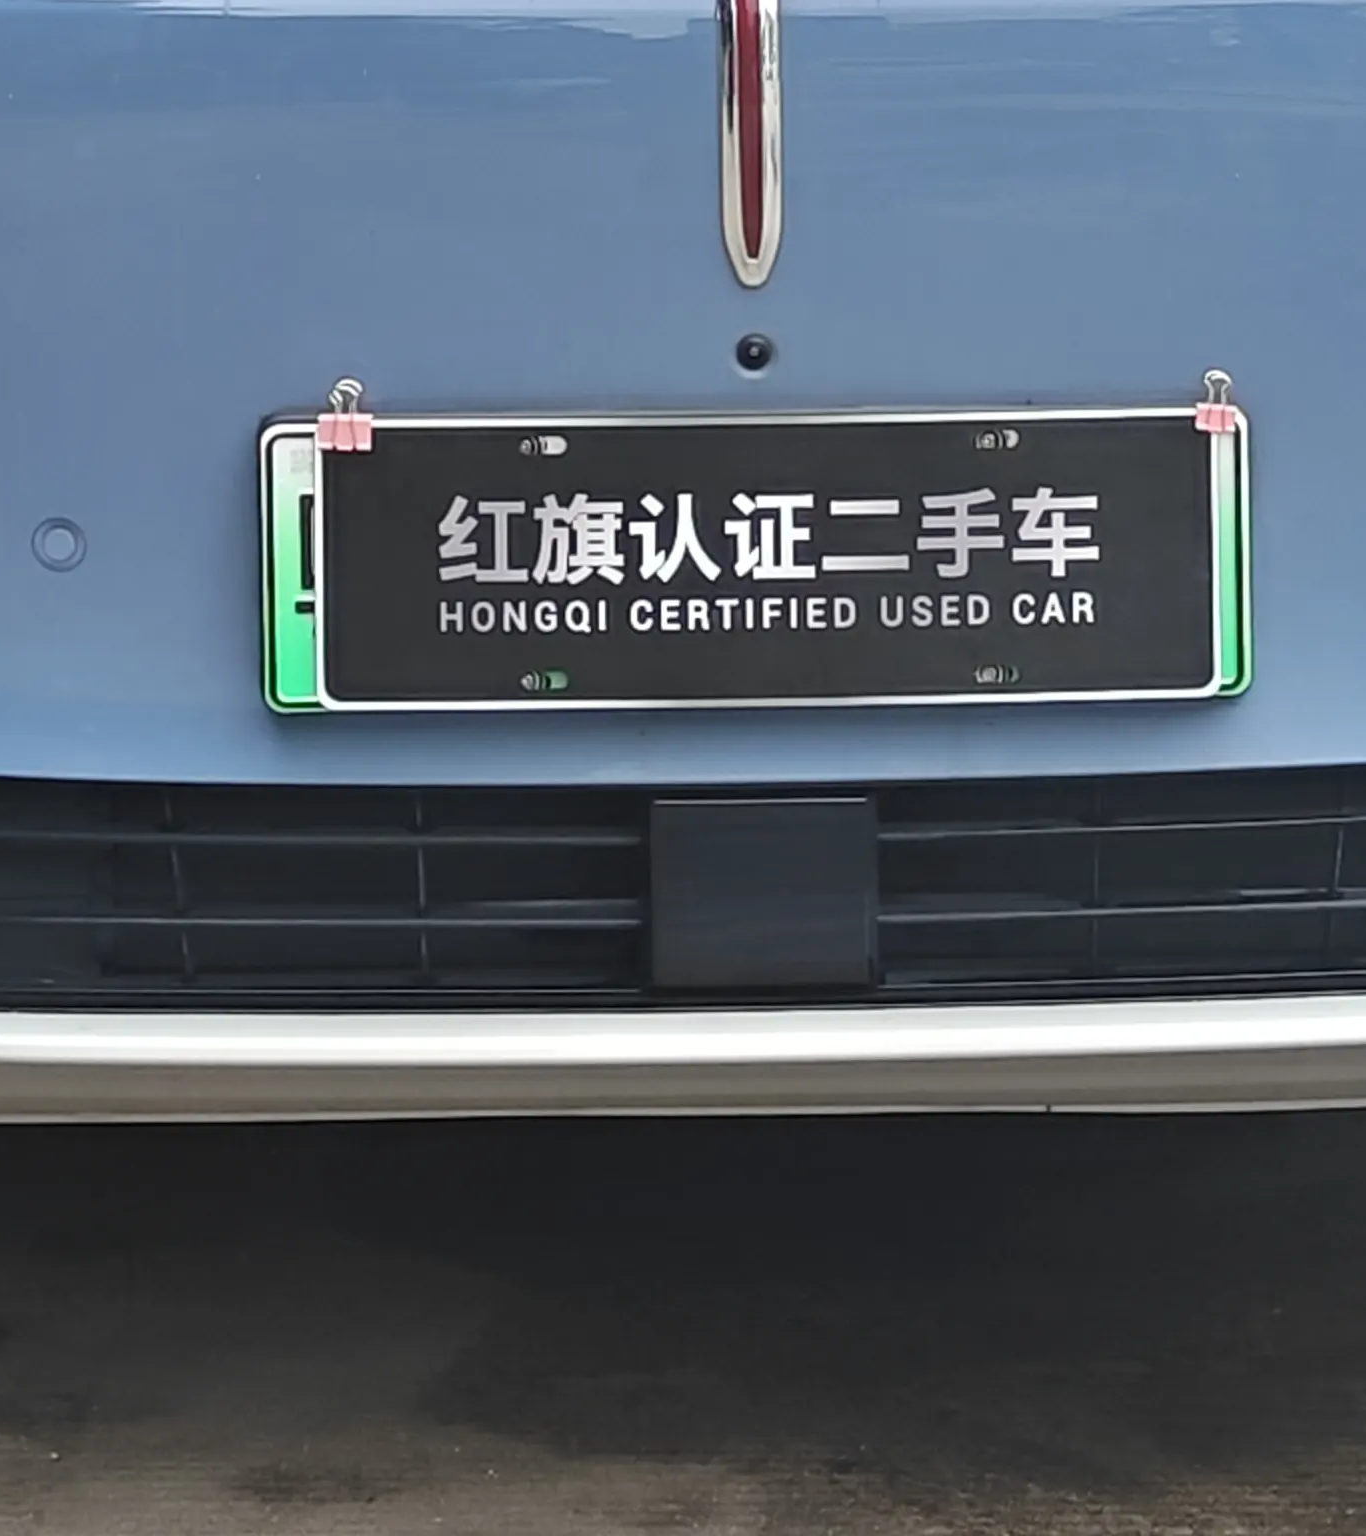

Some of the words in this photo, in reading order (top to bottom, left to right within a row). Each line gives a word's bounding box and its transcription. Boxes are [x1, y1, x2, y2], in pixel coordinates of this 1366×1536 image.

[438, 487, 1100, 585] 红旗认证二手车
[439, 599, 608, 633] HONGQI
[630, 597, 857, 632] CERTIFIED
[880, 595, 990, 627] USED
[1011, 592, 1096, 625] CAR
